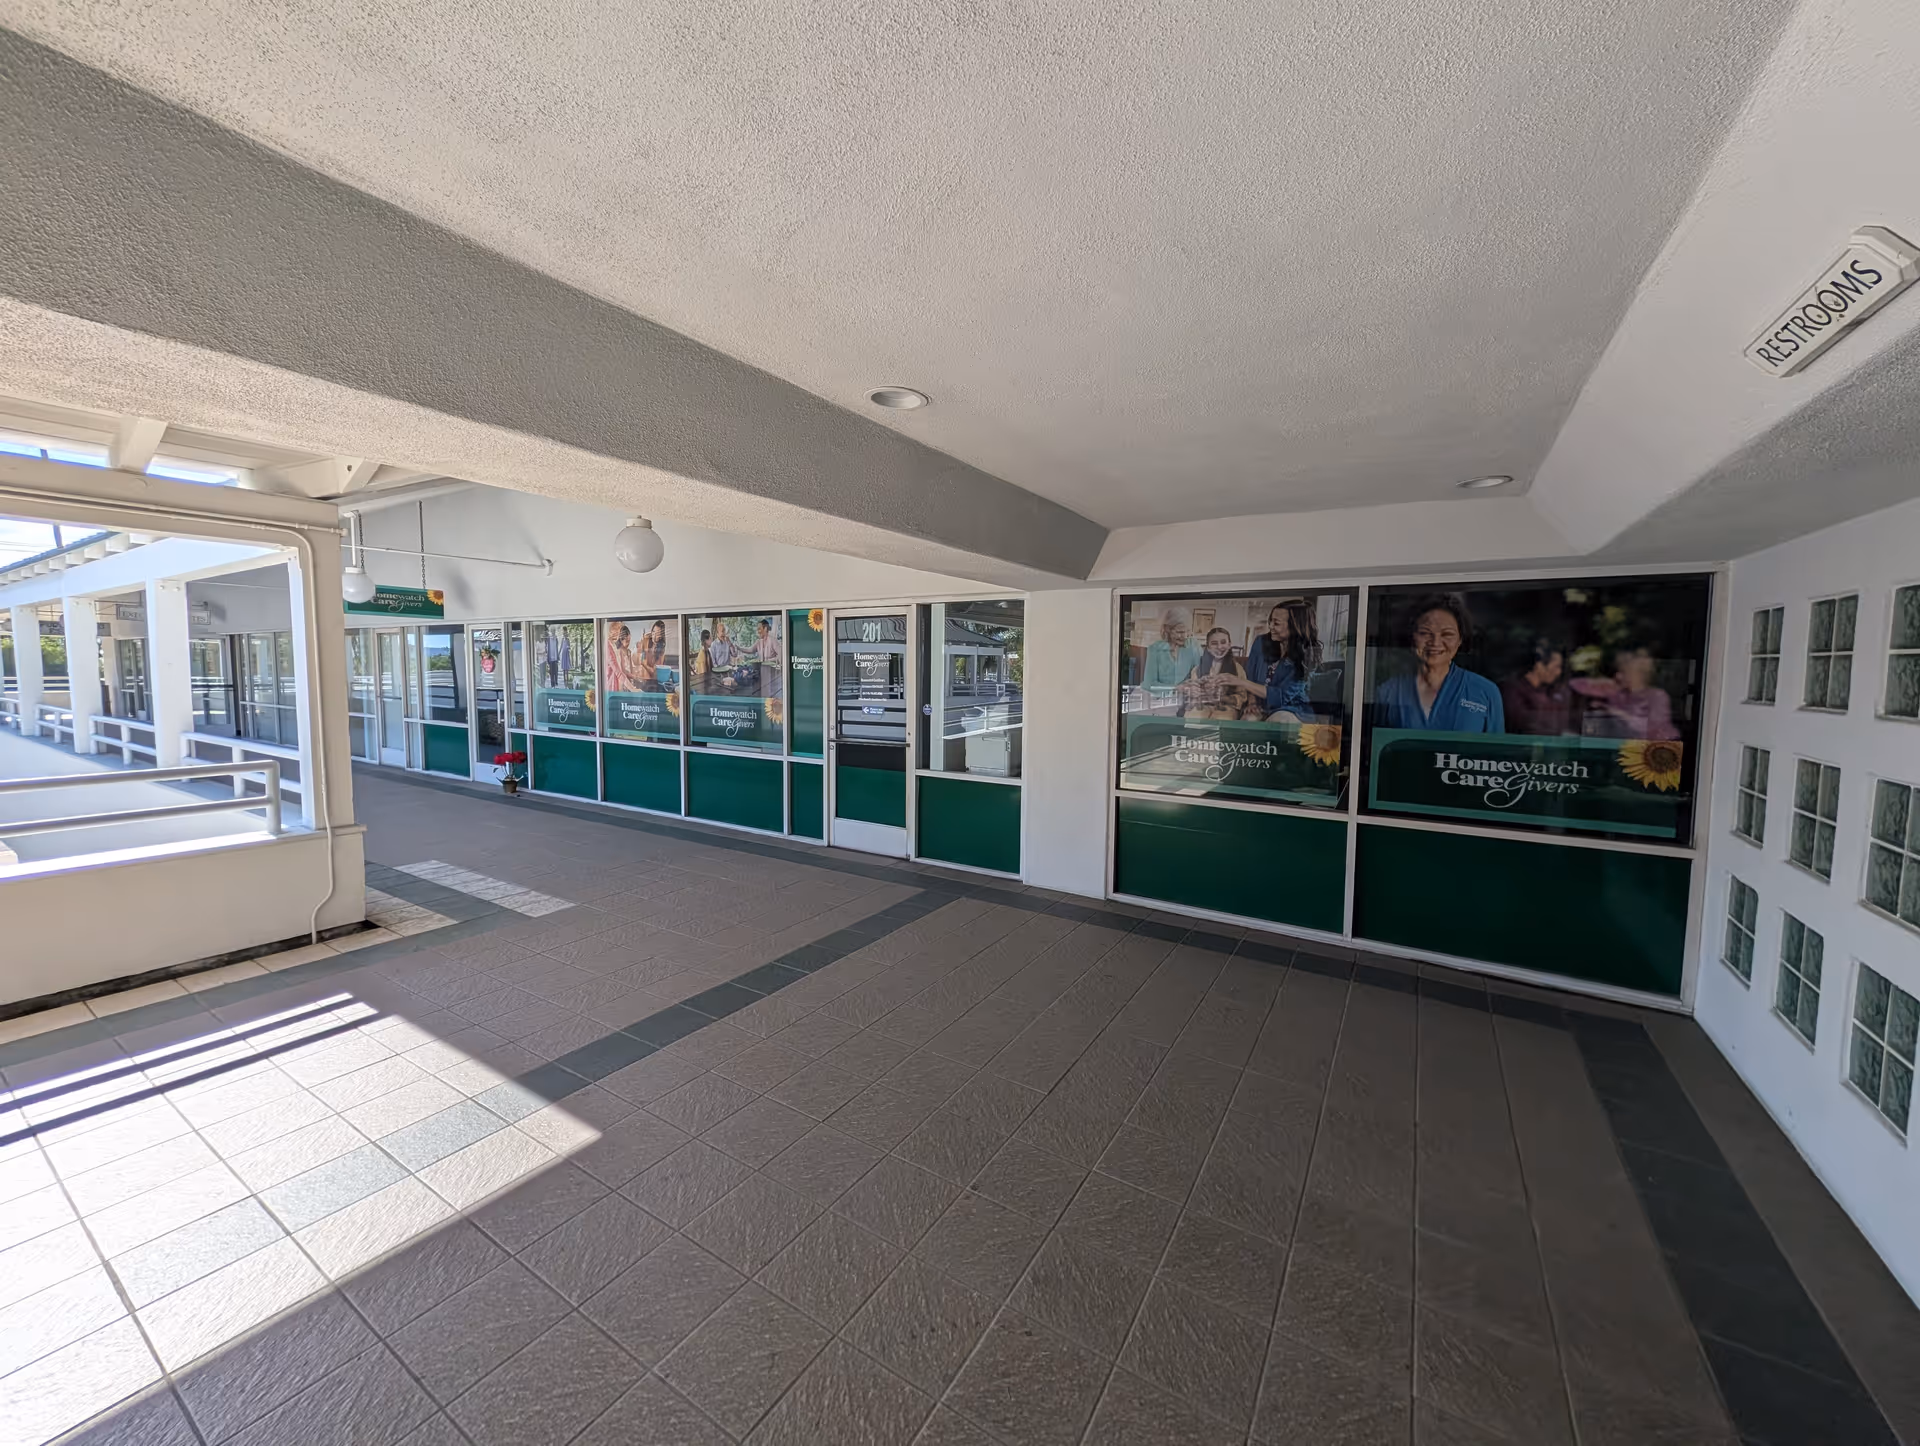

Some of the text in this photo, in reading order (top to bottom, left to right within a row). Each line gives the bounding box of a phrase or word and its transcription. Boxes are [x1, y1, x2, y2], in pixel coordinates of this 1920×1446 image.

[1755, 259, 1883, 367] RESTROOMS
[376, 592, 425, 602] omewatch
[862, 622, 881, 643] 201
[853, 652, 892, 661] Homewatch
[548, 698, 581, 708] Homewatch
[621, 702, 660, 713] Homewatch
[709, 707, 758, 720] Homewatch
[623, 711, 658, 730] CareGivers
[712, 716, 755, 738] CareGivers
[1170, 734, 1278, 756] Homewatch
[1174, 749, 1271, 782] CareGivers
[1433, 752, 1590, 778] Homewatch
[1440, 769, 1580, 808] CareGivers
